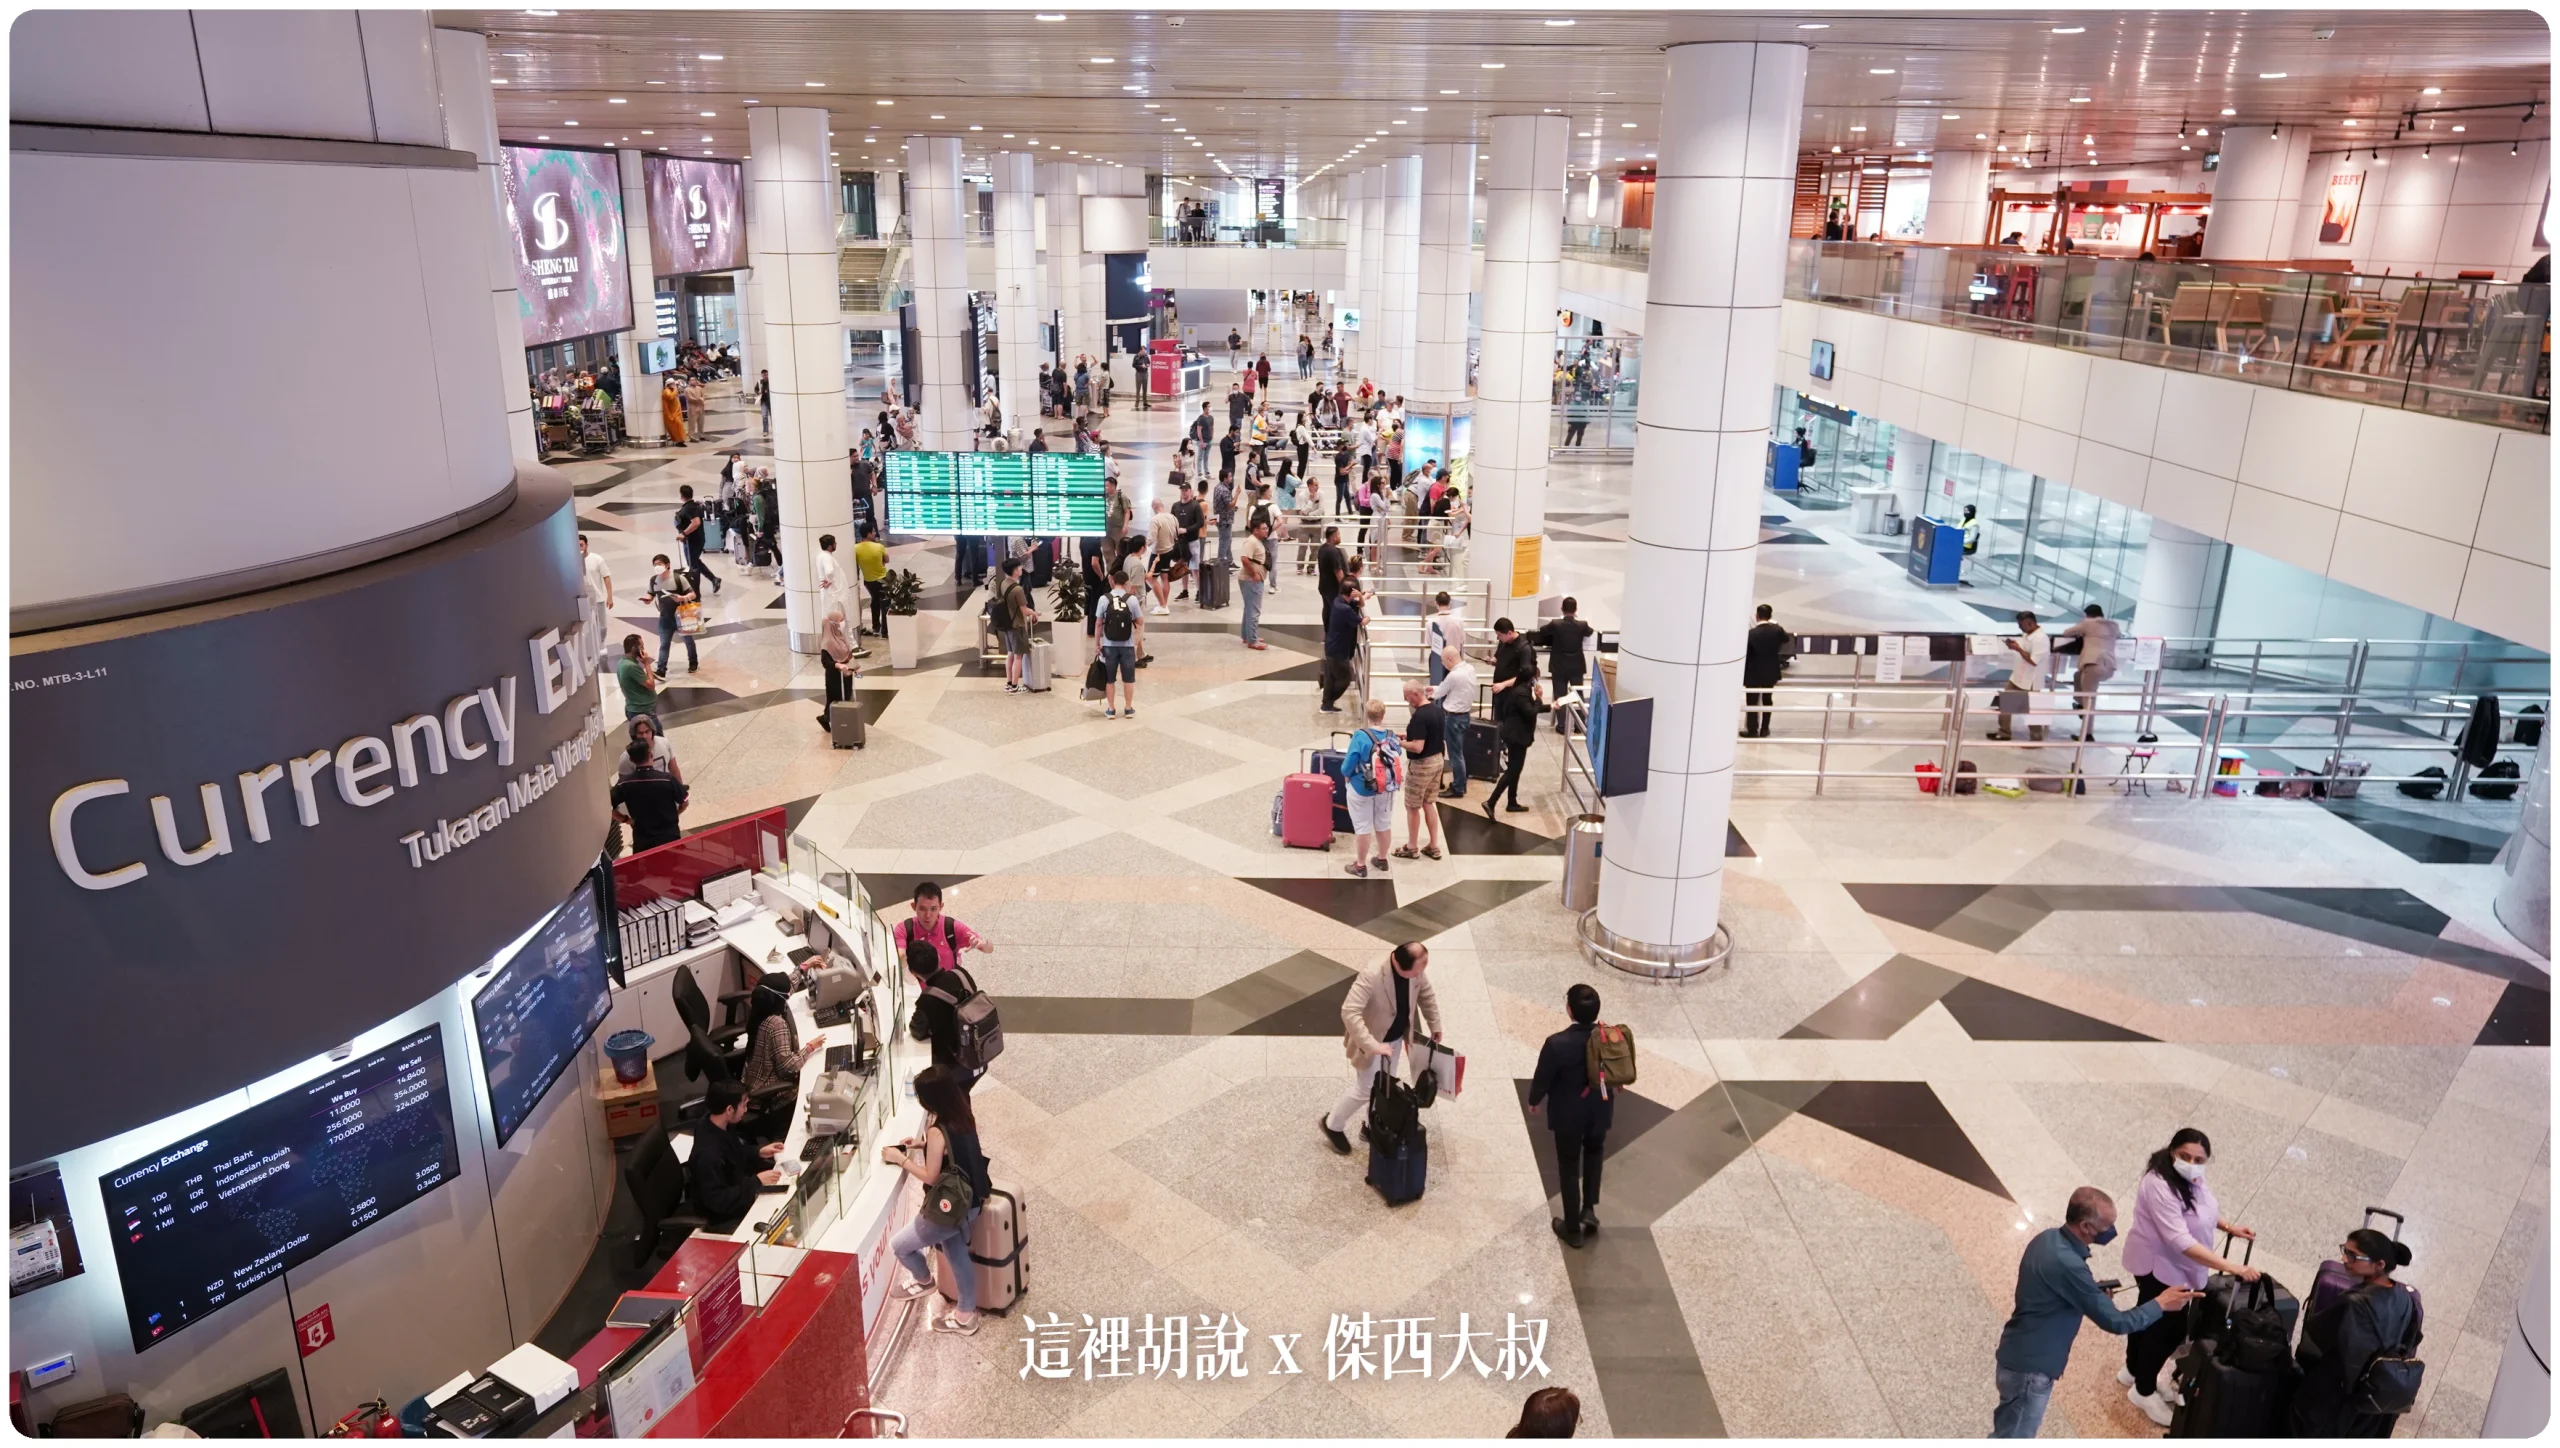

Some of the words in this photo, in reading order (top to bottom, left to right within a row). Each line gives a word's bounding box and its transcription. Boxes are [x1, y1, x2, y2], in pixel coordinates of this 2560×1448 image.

[2332, 174, 2362, 186] BEEFY
[532, 258, 562, 275] SHENG
[563, 257, 578, 273] TAI
[42, 667, 107, 686] MTB-3-L11
[49, 675, 517, 891] Currency
[400, 796, 510, 868] Tukaran
[505, 762, 558, 814] Mata
[552, 728, 592, 778] Wang
[478, 986, 495, 1010] Currency
[494, 968, 512, 994] Exchange
[402, 1042, 416, 1052] BANK
[398, 1063, 410, 1071] We
[410, 1056, 422, 1067] Sell
[342, 1068, 361, 1079] Thursday
[397, 1067, 426, 1085] 14.8400
[331, 1094, 342, 1104] We
[344, 1087, 358, 1098] Buy
[394, 1079, 428, 1100] 354.0000
[330, 1098, 361, 1117] 11.0000
[395, 1091, 429, 1112] 224.0000
[326, 1110, 363, 1134] 256.0000
[328, 1123, 365, 1145] 170.0000
[114, 1161, 160, 1188] Currency
[161, 1139, 209, 1167] Exchange
[213, 1160, 232, 1174] Thai
[233, 1150, 254, 1164] Baht
[215, 1159, 262, 1187] Indonesian
[262, 1146, 291, 1165] Rupiah
[416, 1162, 439, 1179] 3.0500
[185, 1174, 203, 1187] THB
[218, 1172, 268, 1200] Vietnamese
[269, 1160, 291, 1177] Dong
[417, 1174, 441, 1191] 0.3400
[152, 1192, 168, 1204] 100
[189, 1188, 204, 1200] IDR
[158, 1204, 172, 1214] Mil
[190, 1200, 209, 1215] VND
[350, 1196, 377, 1216] 2.5800
[161, 1217, 175, 1228] Mil
[351, 1208, 379, 1228] 0.1500
[233, 1262, 253, 1279] New
[254, 1245, 286, 1268] Zealand
[286, 1233, 310, 1252] Dollar
[869, 1225, 888, 1285] your
[235, 1271, 267, 1292] Turkish
[267, 1261, 283, 1276] Lira
[207, 1279, 224, 1293] NZD
[210, 1292, 226, 1305] TRY
[182, 1312, 187, 1320] 1
